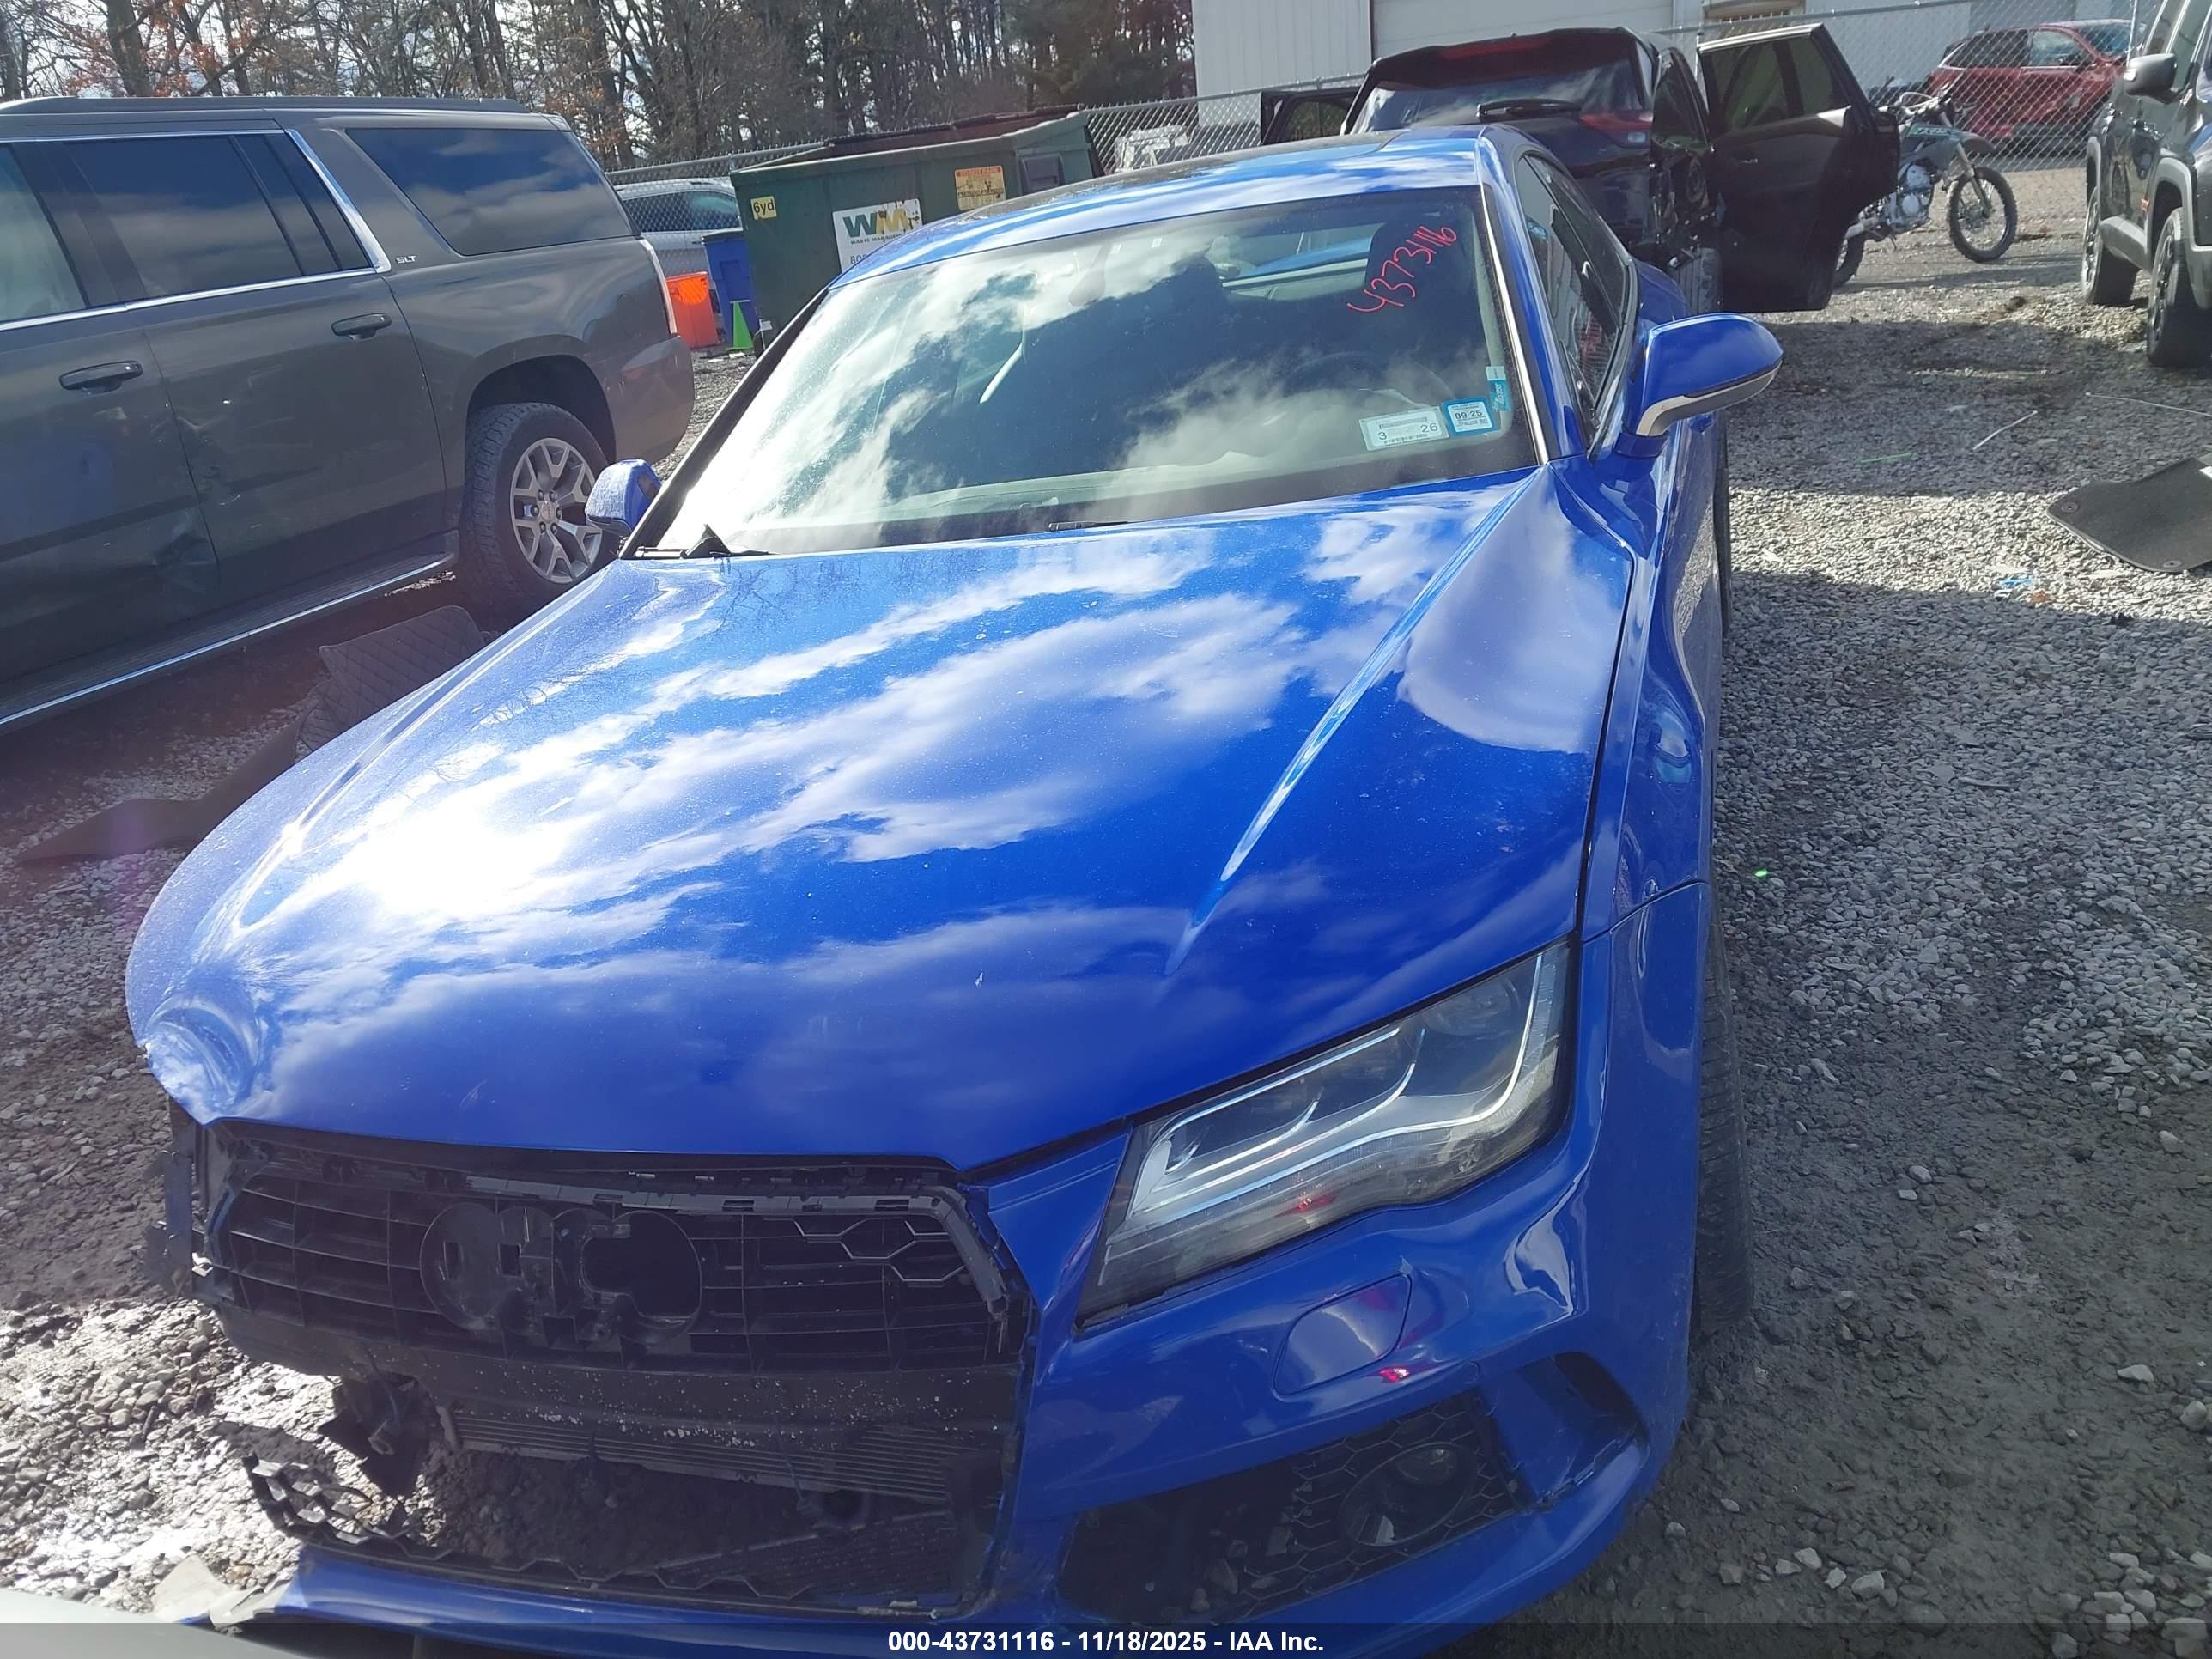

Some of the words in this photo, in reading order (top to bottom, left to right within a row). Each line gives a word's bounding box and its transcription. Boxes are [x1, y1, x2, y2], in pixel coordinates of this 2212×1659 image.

[753, 198, 775, 216] 6yd
[842, 208, 913, 238] WM
[1346, 225, 1457, 313] 43731116
[1377, 431, 1387, 441] 3
[1419, 422, 1438, 433] 26
